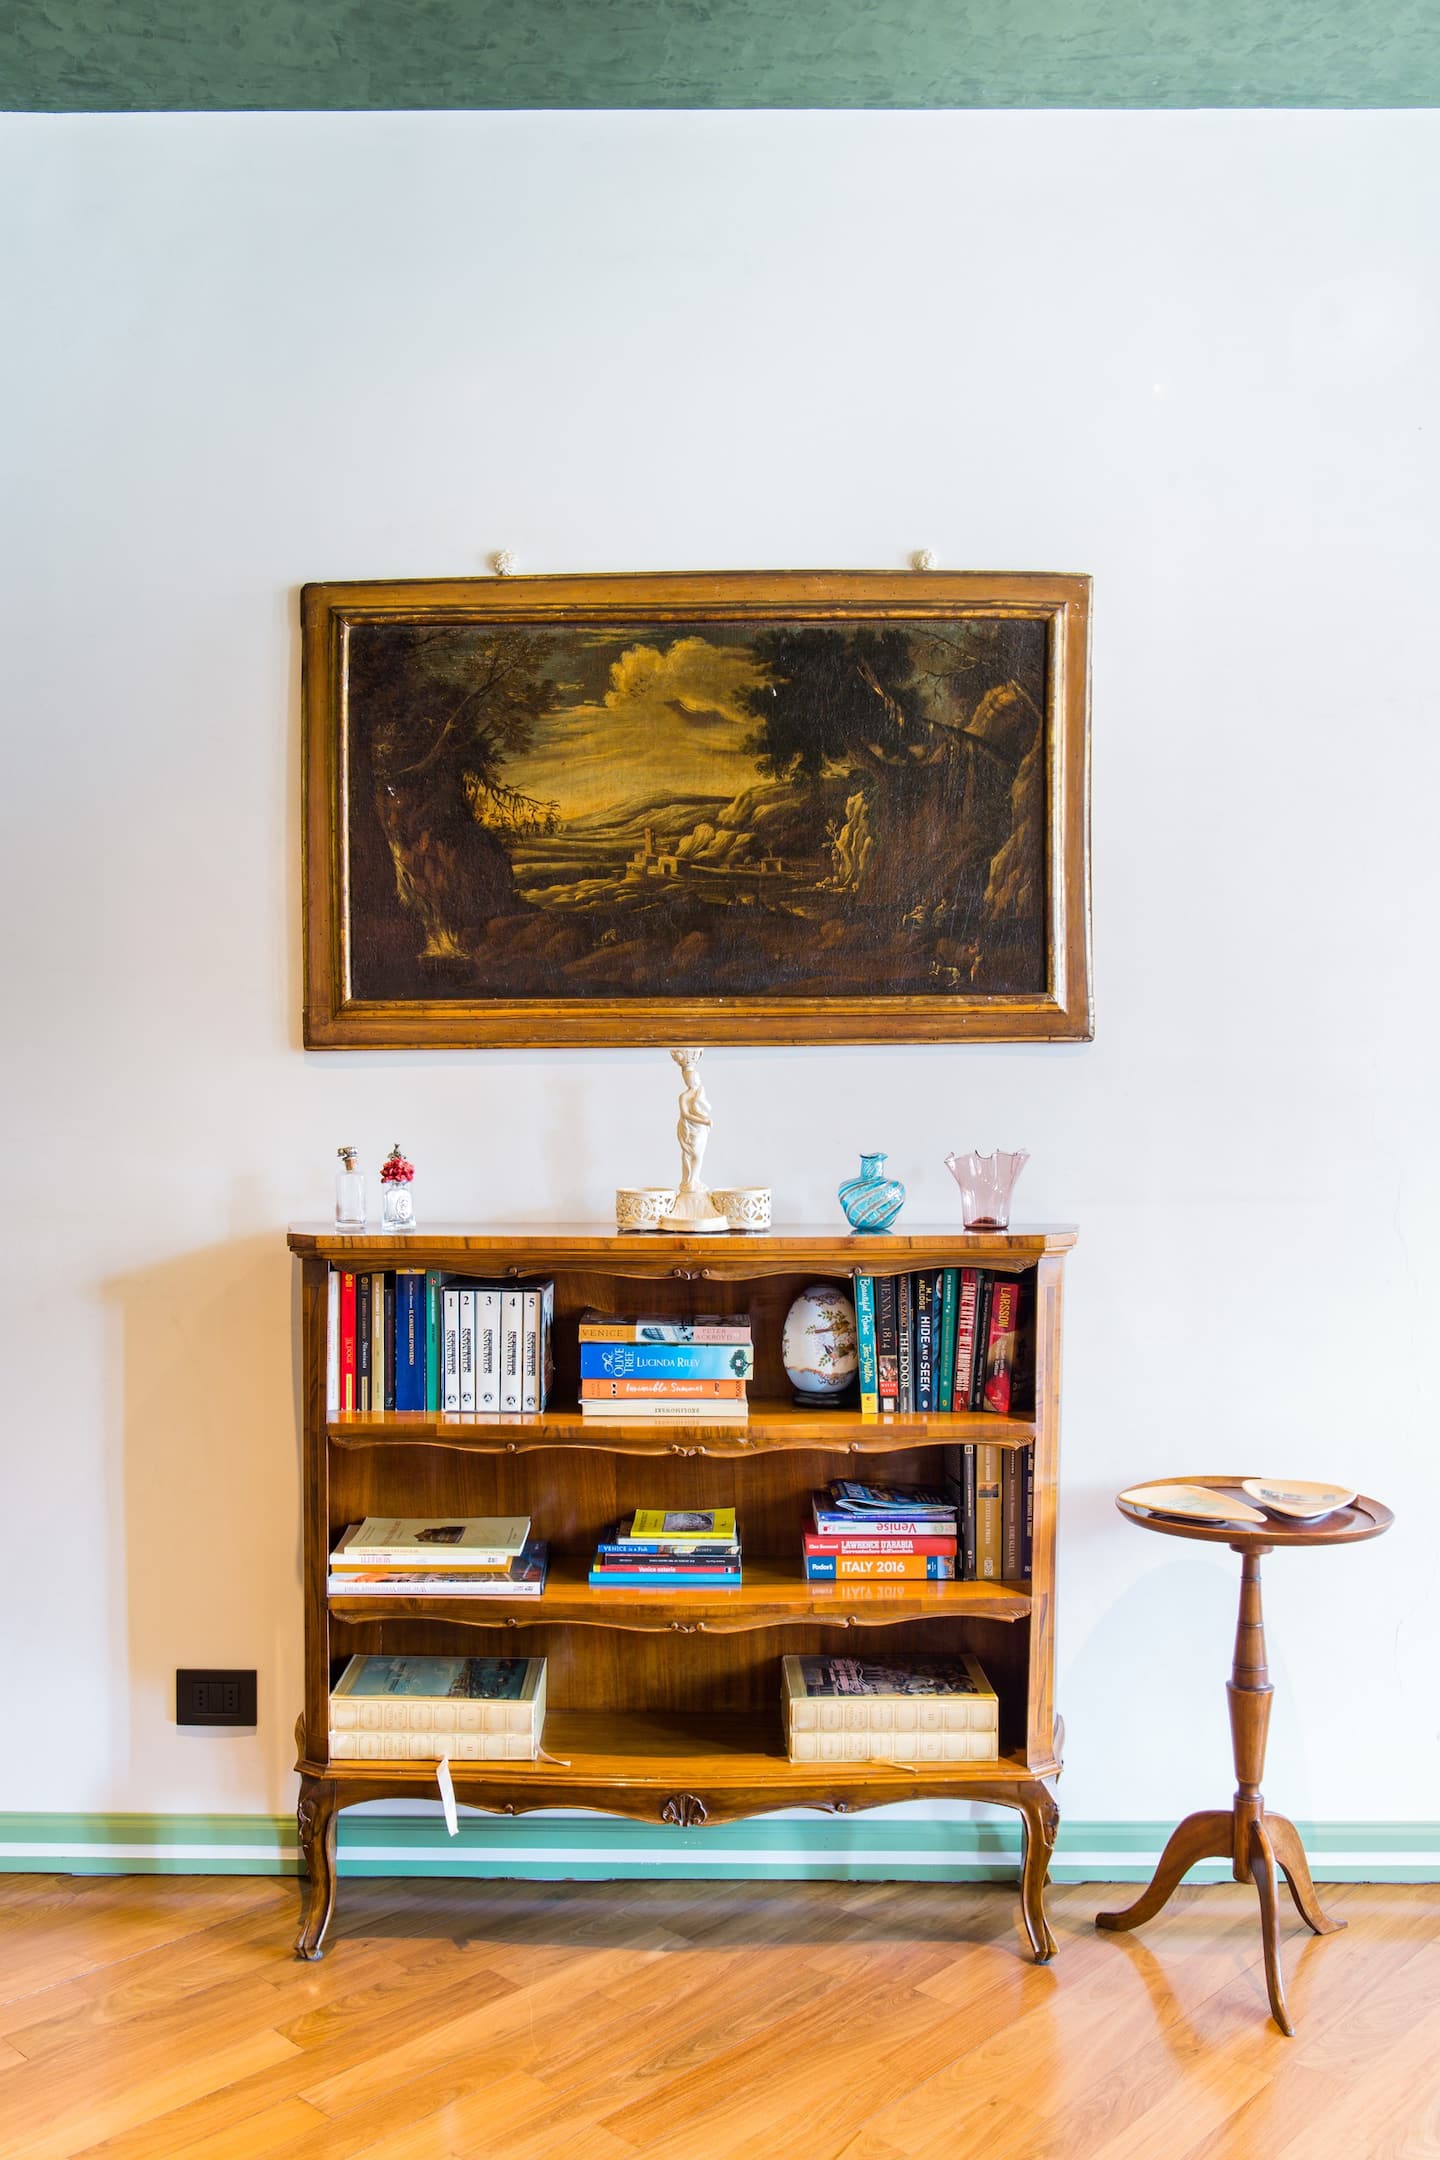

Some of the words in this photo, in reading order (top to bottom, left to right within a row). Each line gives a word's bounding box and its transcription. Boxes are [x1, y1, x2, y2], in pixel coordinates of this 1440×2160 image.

[449, 1298, 453, 1307] 1
[463, 1296, 470, 1306] 2
[485, 1296, 492, 1306] 3
[509, 1297, 516, 1308] 4
[528, 1298, 535, 1308] 5
[858, 1278, 874, 1312] Beautiful
[918, 1279, 926, 1310] ARLIDGE
[961, 1282, 976, 1306] FRANZ
[960, 1306, 975, 1330] KAFKA
[997, 1287, 1011, 1328] LARSSON
[581, 1329, 623, 1337] VENICE
[861, 1313, 873, 1335] Ruins
[920, 1316, 930, 1344] HIDE
[881, 1328, 892, 1349] 1814
[900, 1331, 909, 1353] THE
[624, 1351, 635, 1373] TREE
[861, 1343, 872, 1359] Jess
[921, 1344, 929, 1361] AND
[613, 1348, 625, 1378] OLIVE
[861, 1358, 873, 1384] Walter
[899, 1356, 910, 1389] DOOR
[956, 1335, 972, 1392] METAMORPHOSIS
[671, 1382, 703, 1392] Summer
[920, 1362, 930, 1392] SEEK
[876, 1522, 916, 1534] Venise
[841, 1541, 880, 1549] LAWRENCE
[881, 1541, 914, 1549] D'ARABIA
[841, 1561, 873, 1573] ITALY
[877, 1561, 906, 1573] 2016
